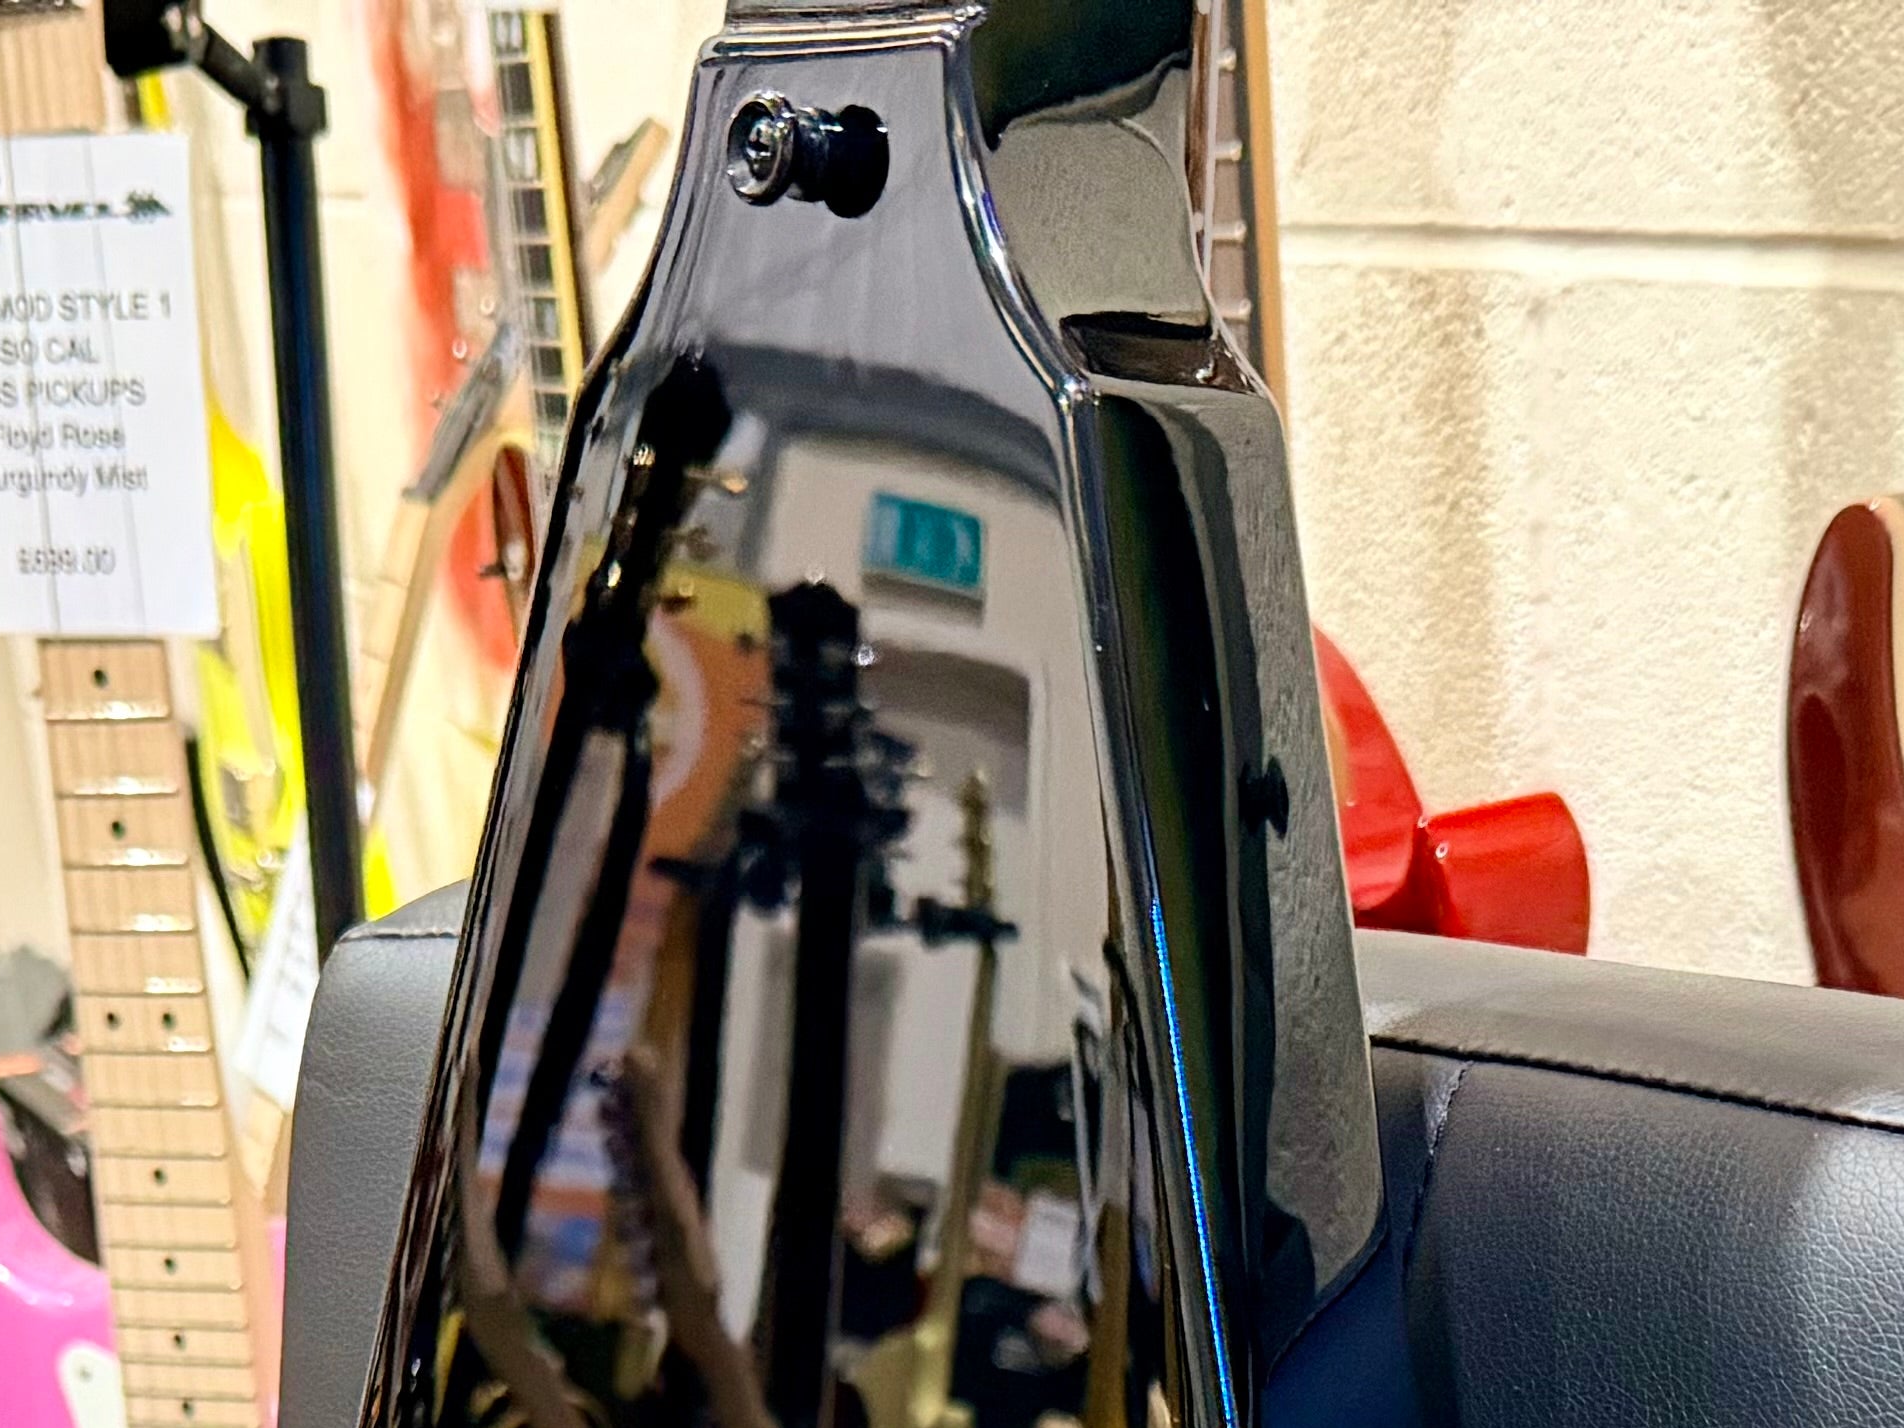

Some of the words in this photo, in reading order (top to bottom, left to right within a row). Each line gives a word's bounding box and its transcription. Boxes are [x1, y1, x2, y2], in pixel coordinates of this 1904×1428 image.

[58, 290, 148, 321] STYLE
[45, 338, 99, 365] CAL
[24, 377, 147, 407] PICKUPS
[59, 422, 126, 449] Rose
[94, 462, 149, 491] Mist
